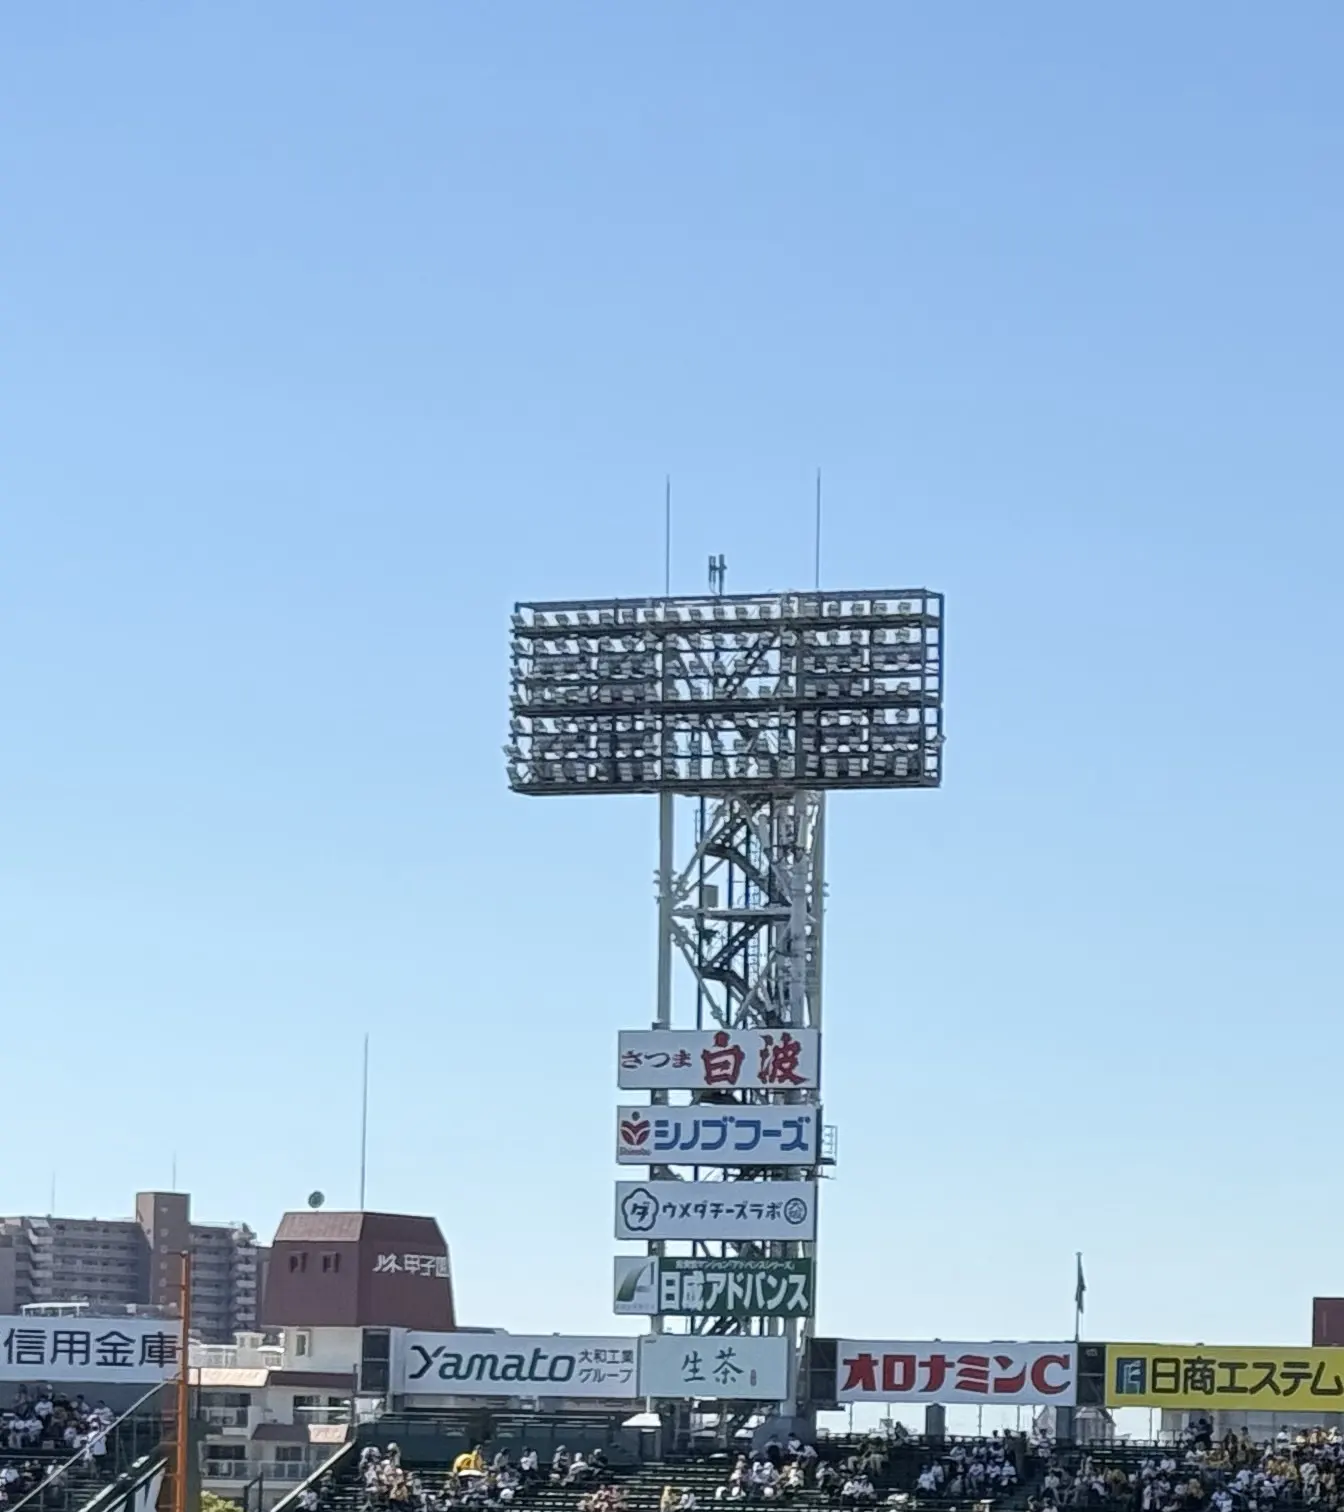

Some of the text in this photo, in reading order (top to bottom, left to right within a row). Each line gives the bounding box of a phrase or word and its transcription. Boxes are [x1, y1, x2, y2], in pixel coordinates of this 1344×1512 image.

[621, 1031, 810, 1086] さつま 白波
[654, 1115, 812, 1152] シノブフーズ
[661, 1202, 782, 1222] ウメダチーズラボ
[3, 1327, 179, 1369] 信用金庫
[408, 1345, 576, 1382] Yamato
[578, 1348, 635, 1365] 大和工業
[681, 1346, 744, 1387] 生茶
[578, 1367, 634, 1385] グループ
[841, 1354, 1071, 1396] オロナミンC
[1151, 1357, 1344, 1397] 日商エステム
